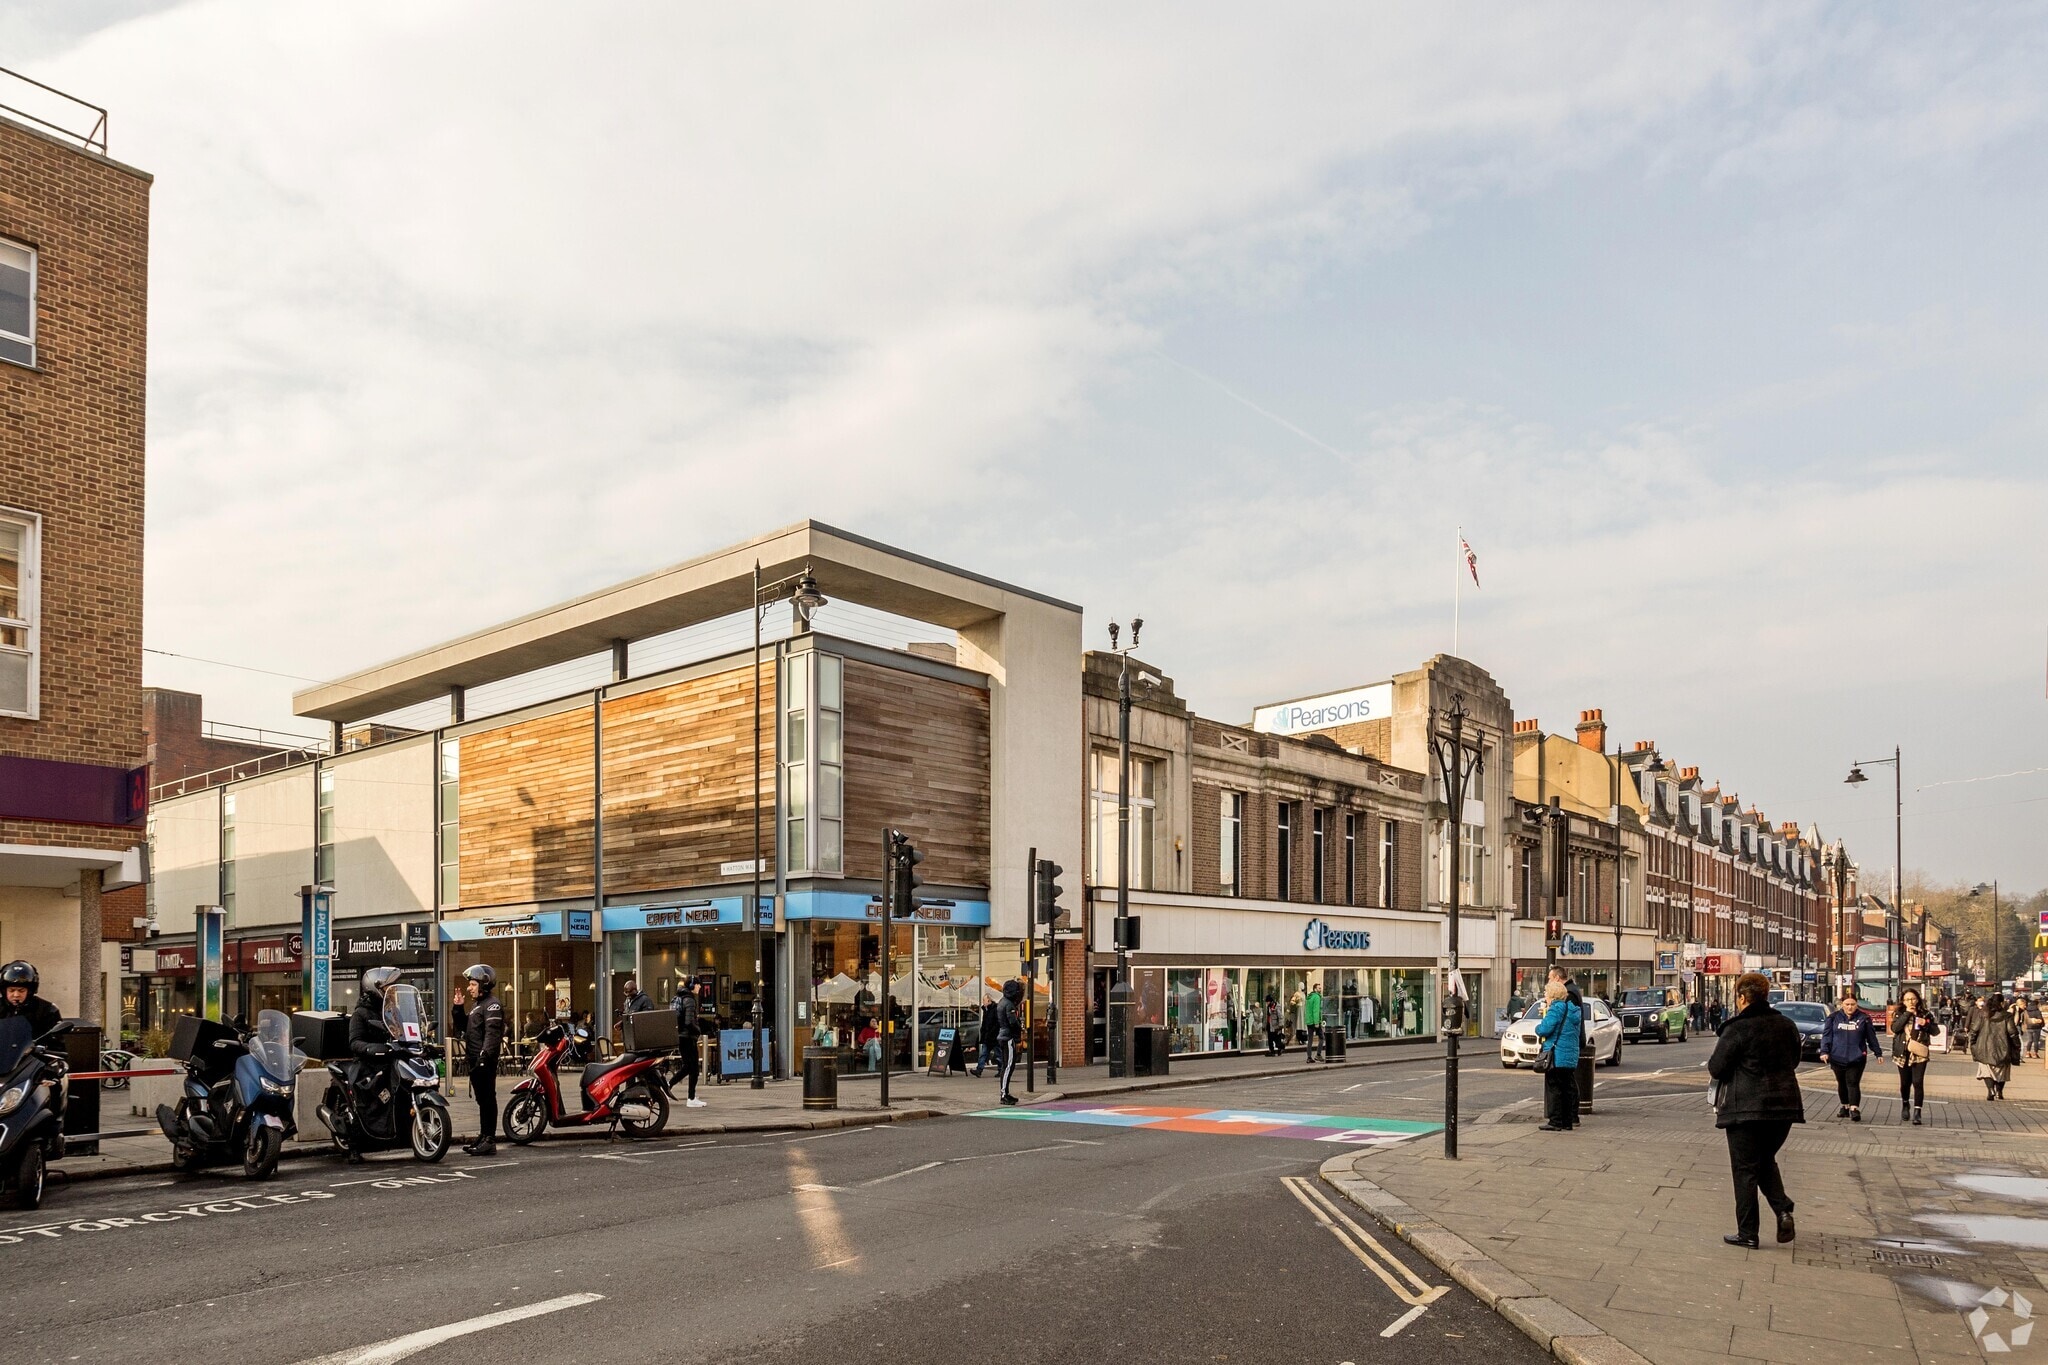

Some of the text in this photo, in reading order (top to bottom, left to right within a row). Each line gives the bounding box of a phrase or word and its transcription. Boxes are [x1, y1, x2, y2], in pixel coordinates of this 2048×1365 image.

[1290, 699, 1370, 729] Pearsons
[685, 908, 719, 923] NERO
[914, 906, 951, 921] NERO
[515, 921, 541, 935] NERO
[570, 923, 590, 931] NERO
[1320, 921, 1371, 950] Pearsons
[348, 936, 382, 954] Lumiere
[1570, 935, 1595, 956] Pearsons
[316, 912, 327, 1012] PALACE EXCHANG
[407, 1025, 418, 1037] L
[727, 1048, 753, 1061] NER
[370, 1170, 475, 1190] ONLY
